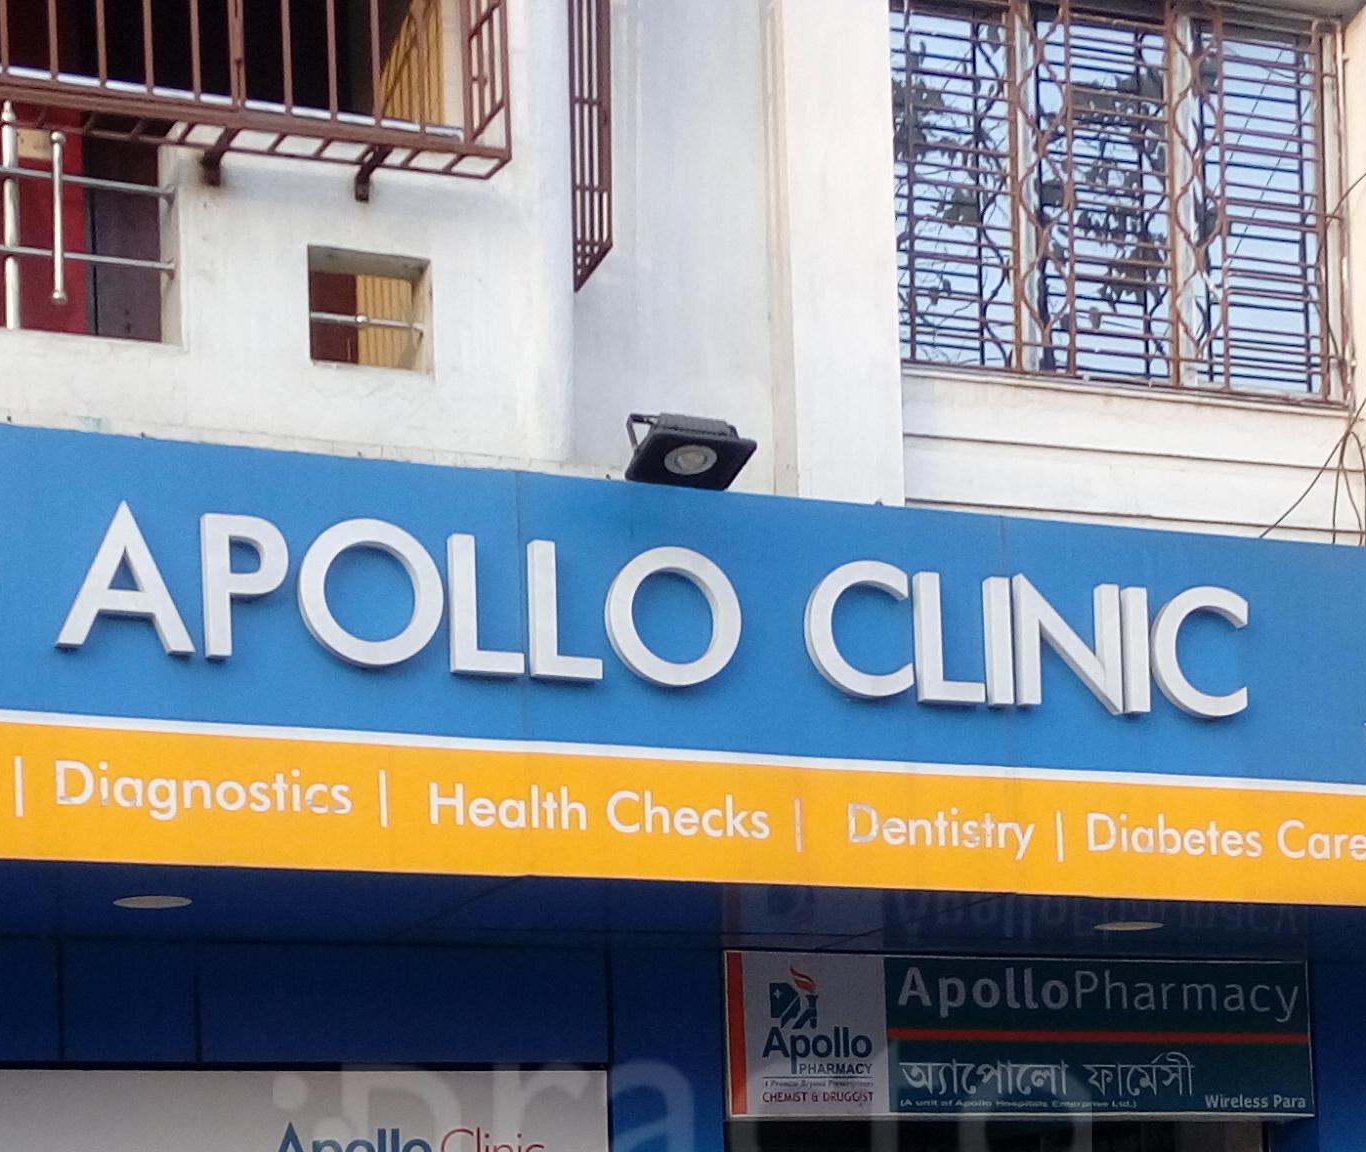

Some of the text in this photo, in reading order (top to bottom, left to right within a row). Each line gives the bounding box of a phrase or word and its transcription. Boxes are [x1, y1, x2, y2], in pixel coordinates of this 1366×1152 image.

[55, 499, 1250, 719] APOLLO CLINIC
[53, 759, 355, 822] Diagnostics
[426, 783, 589, 833] Health
[604, 790, 770, 841] Checks
[847, 802, 1036, 860] Dentistry
[1087, 813, 1262, 859] Diabetes
[762, 1026, 872, 1074] Apollo
[799, 1063, 872, 1074] PHARMACY
[899, 1051, 1195, 1097] অ্যাপোলো ফার্মেসী
[762, 1092, 803, 1103] CHEMIST
[823, 1092, 873, 1103] DRUGGIST
[955, 1099, 992, 1109] Apollo
[1205, 1095, 1306, 1110] Wireless Para
